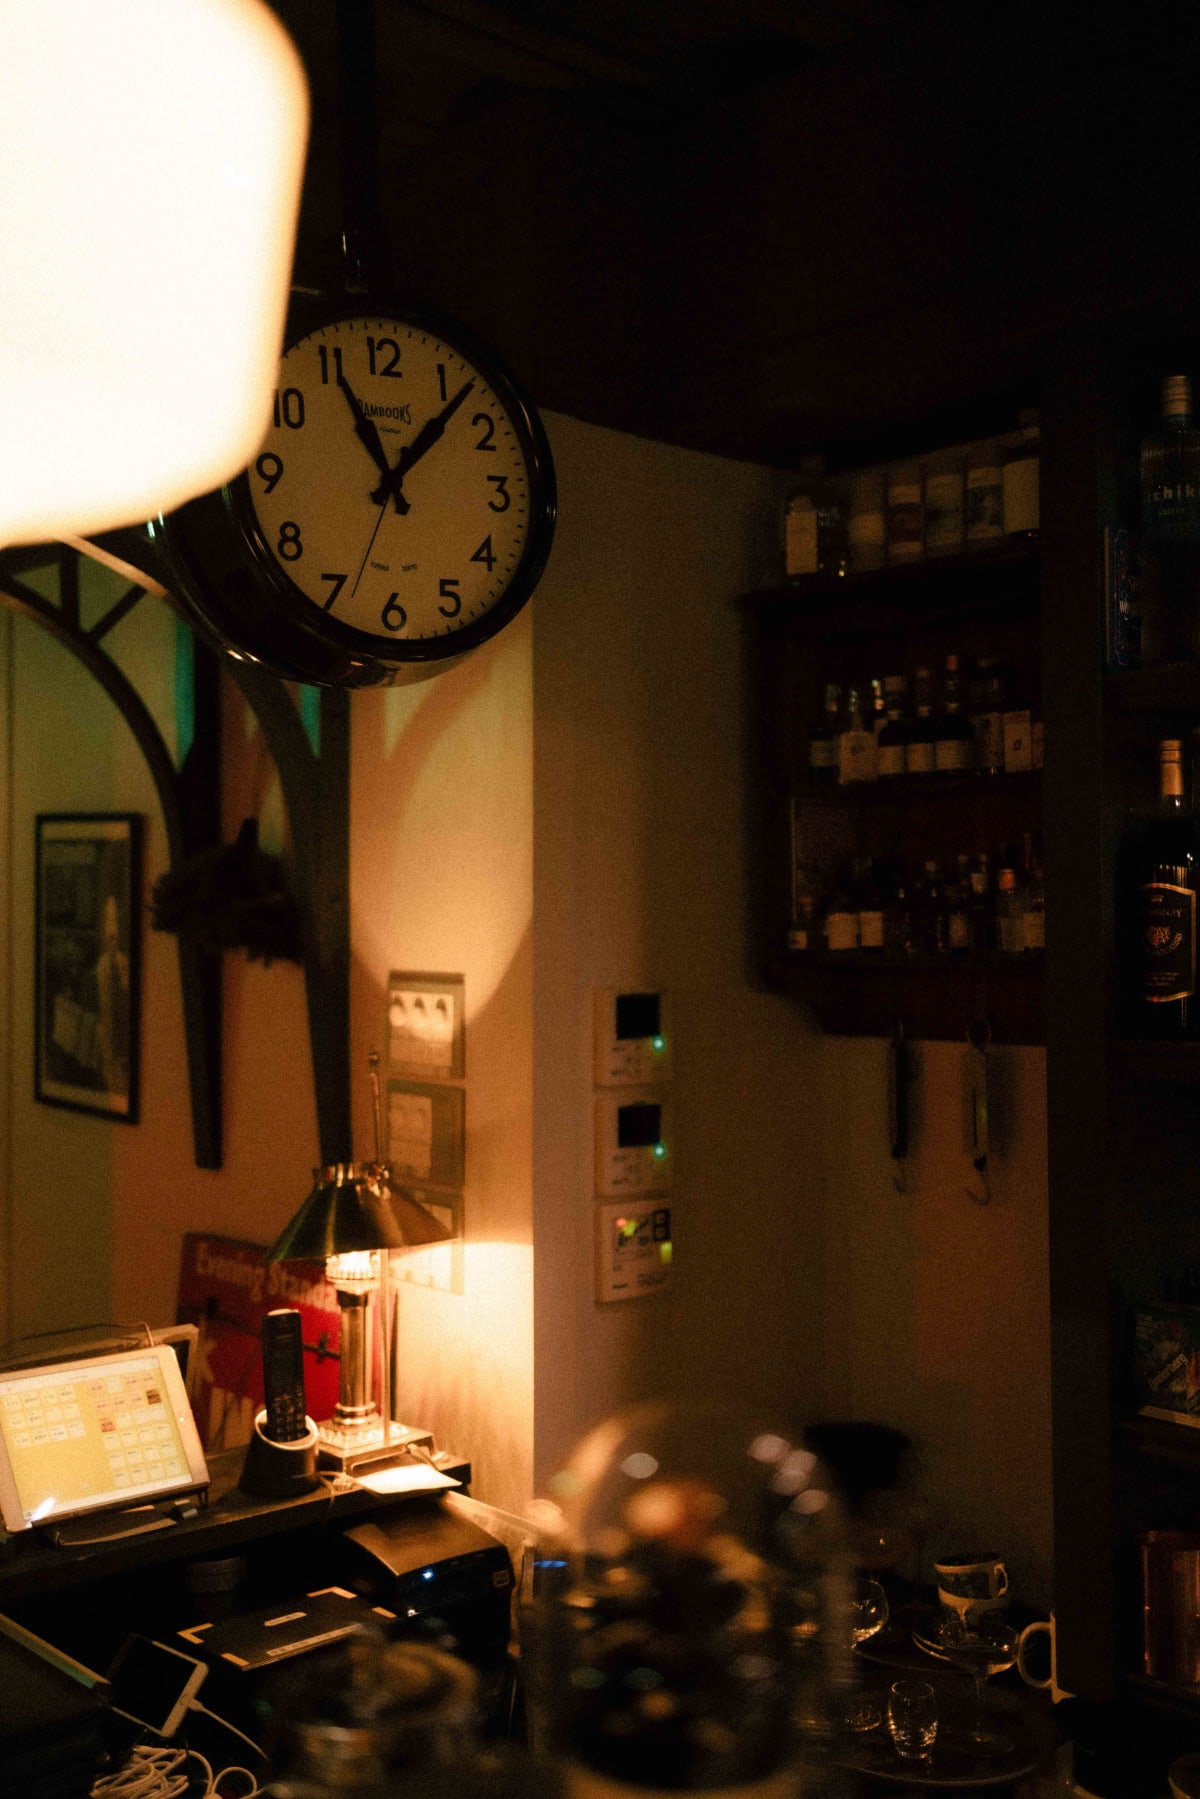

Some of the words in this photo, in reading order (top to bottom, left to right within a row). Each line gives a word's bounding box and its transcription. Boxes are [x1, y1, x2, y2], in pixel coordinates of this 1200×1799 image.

[318, 345, 344, 387] 11
[366, 336, 403, 378] 12
[437, 364, 447, 401] 1
[273, 387, 305, 429] 10
[471, 413, 497, 451] 2
[256, 452, 284, 494] 9
[486, 475, 511, 513] 3
[277, 521, 303, 561] 8
[469, 534, 498, 572] 4
[321, 573, 348, 613] 7
[381, 592, 407, 632] 6
[438, 579, 462, 618] 5
[267, 1262, 342, 1315] Standa
